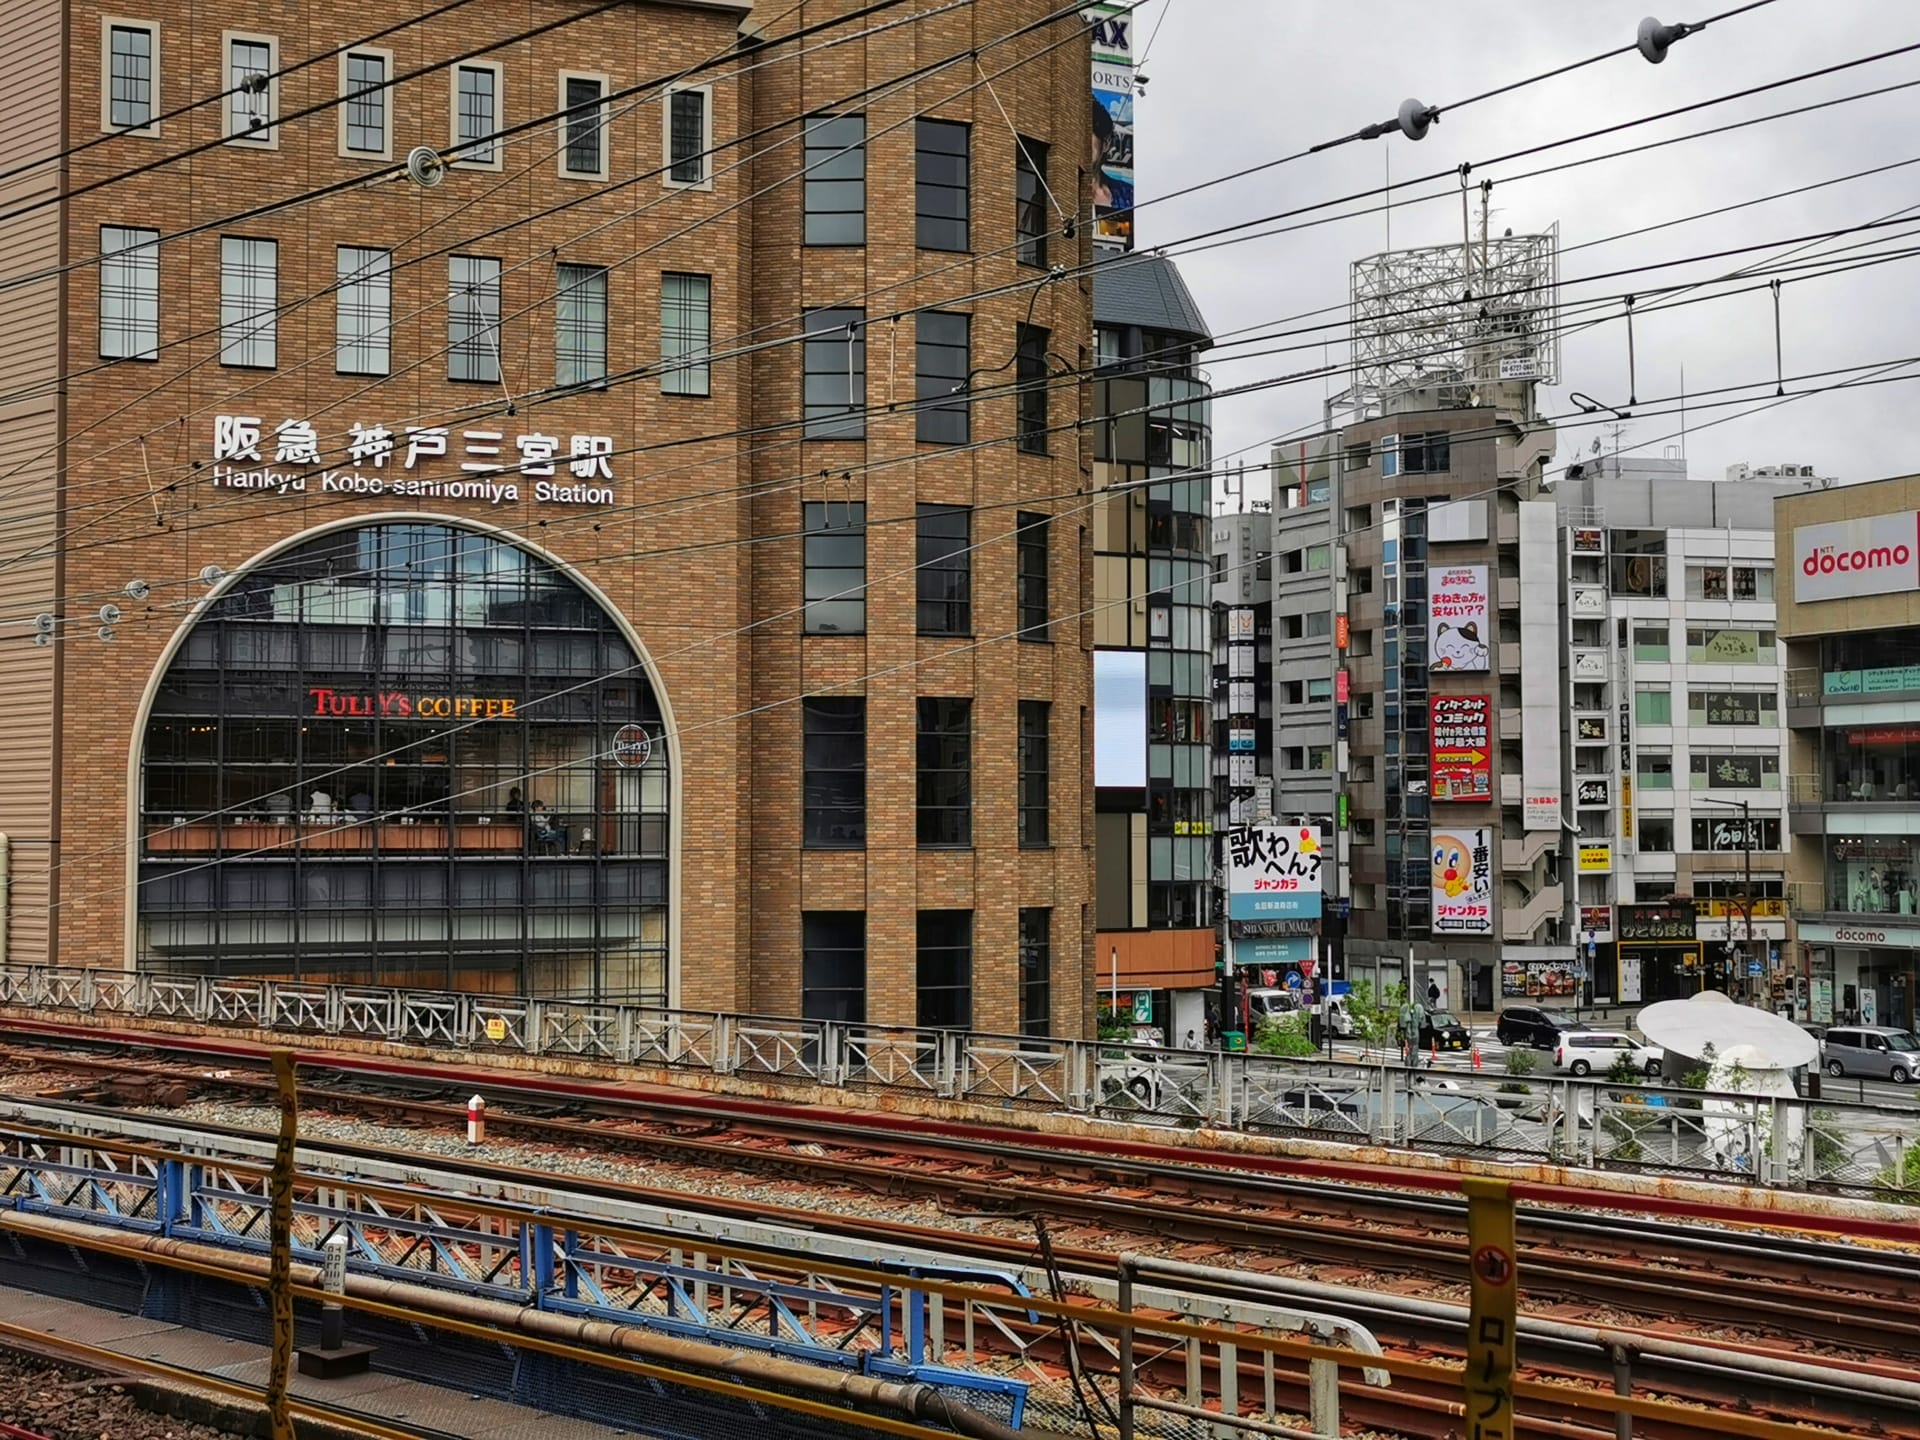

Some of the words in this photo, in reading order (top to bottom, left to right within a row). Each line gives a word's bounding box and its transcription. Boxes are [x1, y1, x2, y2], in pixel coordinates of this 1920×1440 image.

[214, 415, 320, 464] 阪急
[347, 422, 614, 480] 神戸三宮駅
[213, 466, 306, 496] Hankyu
[322, 471, 519, 504] Kobe-sannomiya
[534, 481, 614, 505] Station
[1803, 545, 1910, 576] docomo
[1820, 546, 1834, 555] NTT
[1432, 593, 1486, 604] まねきの方が
[309, 689, 412, 717] TULLY'S
[418, 697, 516, 717] COFFEE
[1709, 709, 1756, 721] 全席個室
[1230, 827, 1290, 868] 歌わ
[1473, 829, 1489, 893] 1番安い
[1254, 878, 1298, 890] ジャンカラ
[1438, 905, 1488, 916] ジャンカラ
[1836, 928, 1885, 942] docomo
